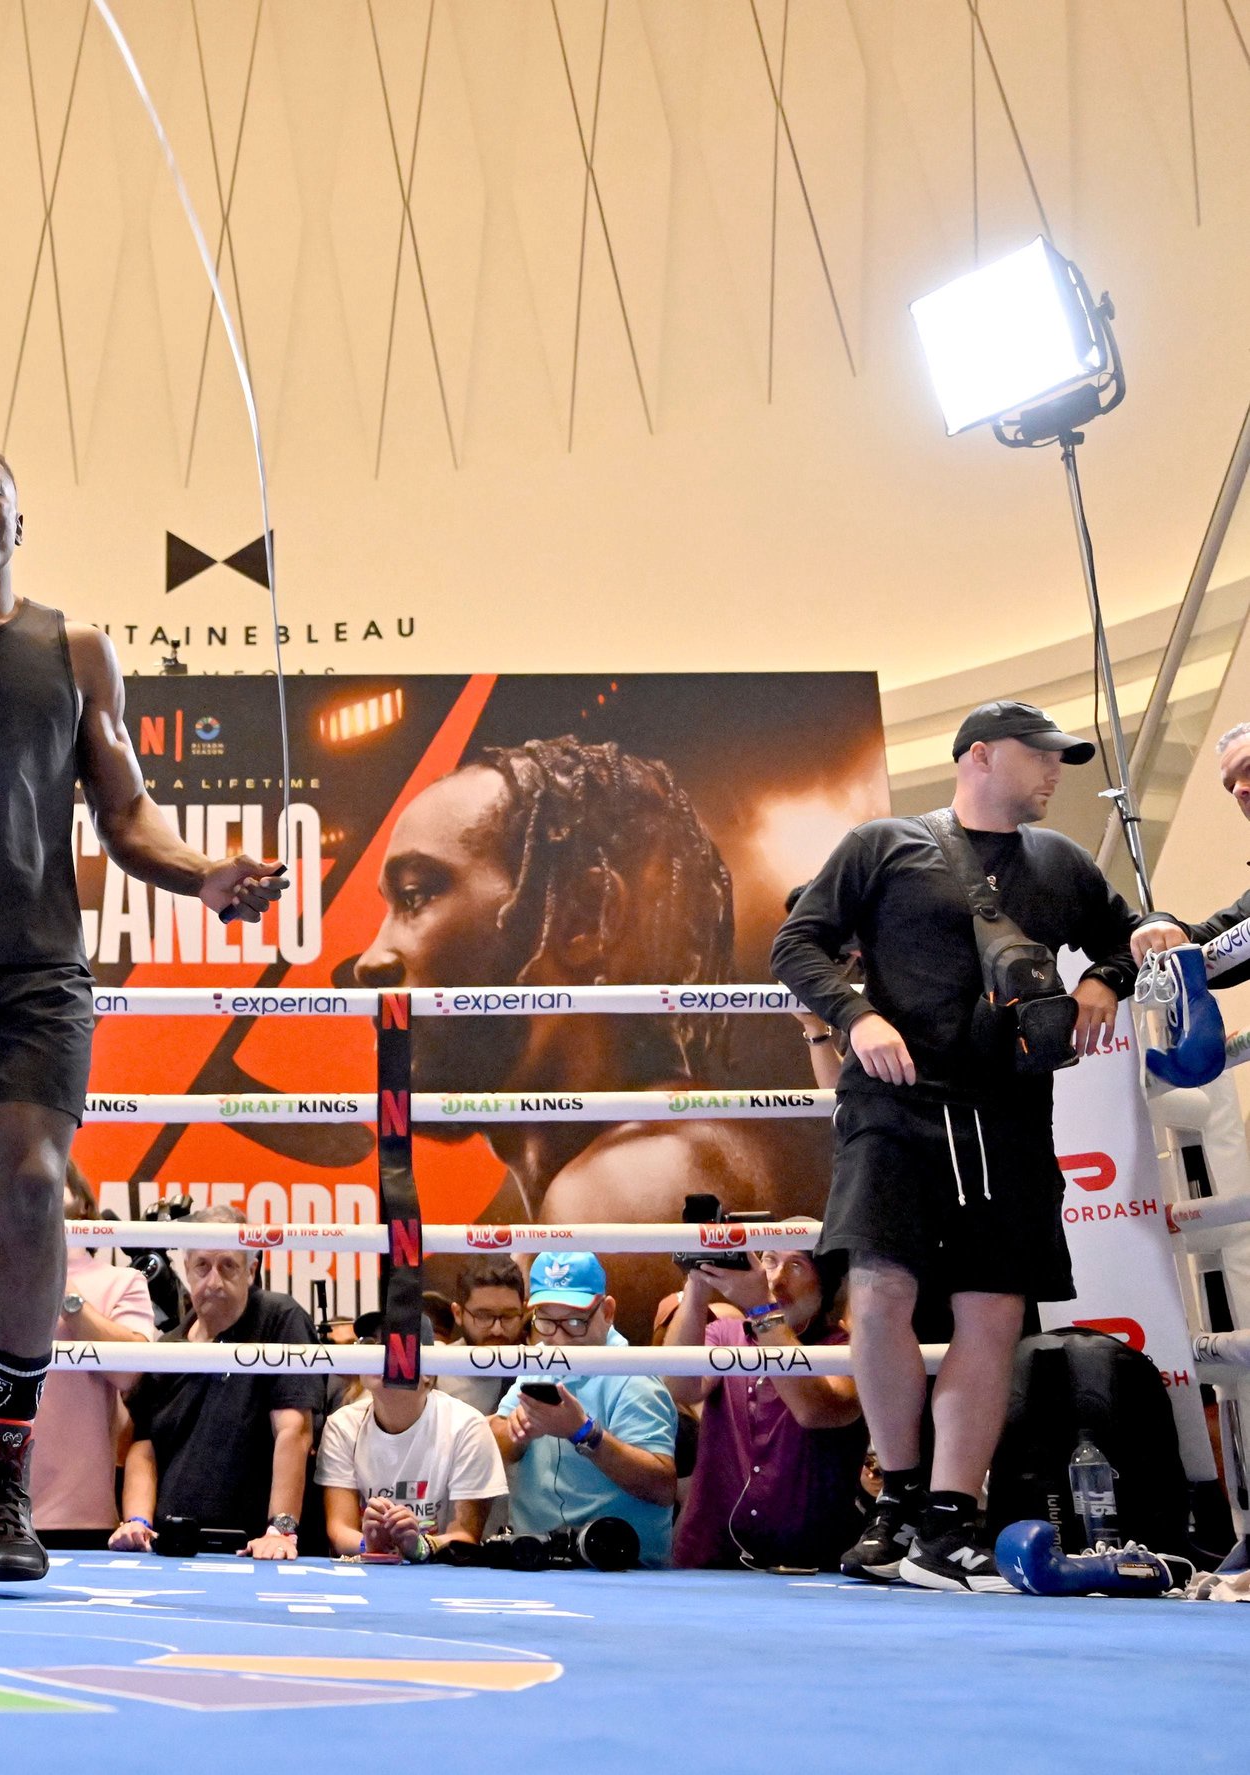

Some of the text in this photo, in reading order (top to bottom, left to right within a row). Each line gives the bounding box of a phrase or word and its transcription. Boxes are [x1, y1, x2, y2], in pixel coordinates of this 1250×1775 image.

[91, 617, 415, 646] TAINEBLEAU
[140, 716, 164, 756] N
[143, 779, 320, 789] N A LIFETIME
[71, 803, 322, 965] CANELO
[232, 992, 350, 1015] experian
[381, 993, 408, 1030] N
[453, 991, 574, 1013] experian
[679, 990, 802, 1011] experian
[219, 1098, 358, 1117] DRAFTKINGS
[382, 1091, 408, 1136] N
[441, 1096, 584, 1116] DRAFTKINGS
[669, 1093, 815, 1113] DRAFTKINGS
[1063, 1198, 1158, 1224] ORDASH
[92, 1224, 115, 1235] box
[240, 1224, 282, 1246] Jack
[468, 1225, 510, 1246] Jack
[700, 1223, 745, 1246] Jack
[392, 1219, 419, 1268] N
[53, 1342, 102, 1365] RA
[234, 1342, 335, 1368] OURA
[388, 1334, 415, 1380] N
[469, 1345, 572, 1371] OURA
[708, 1346, 813, 1373] OURA
